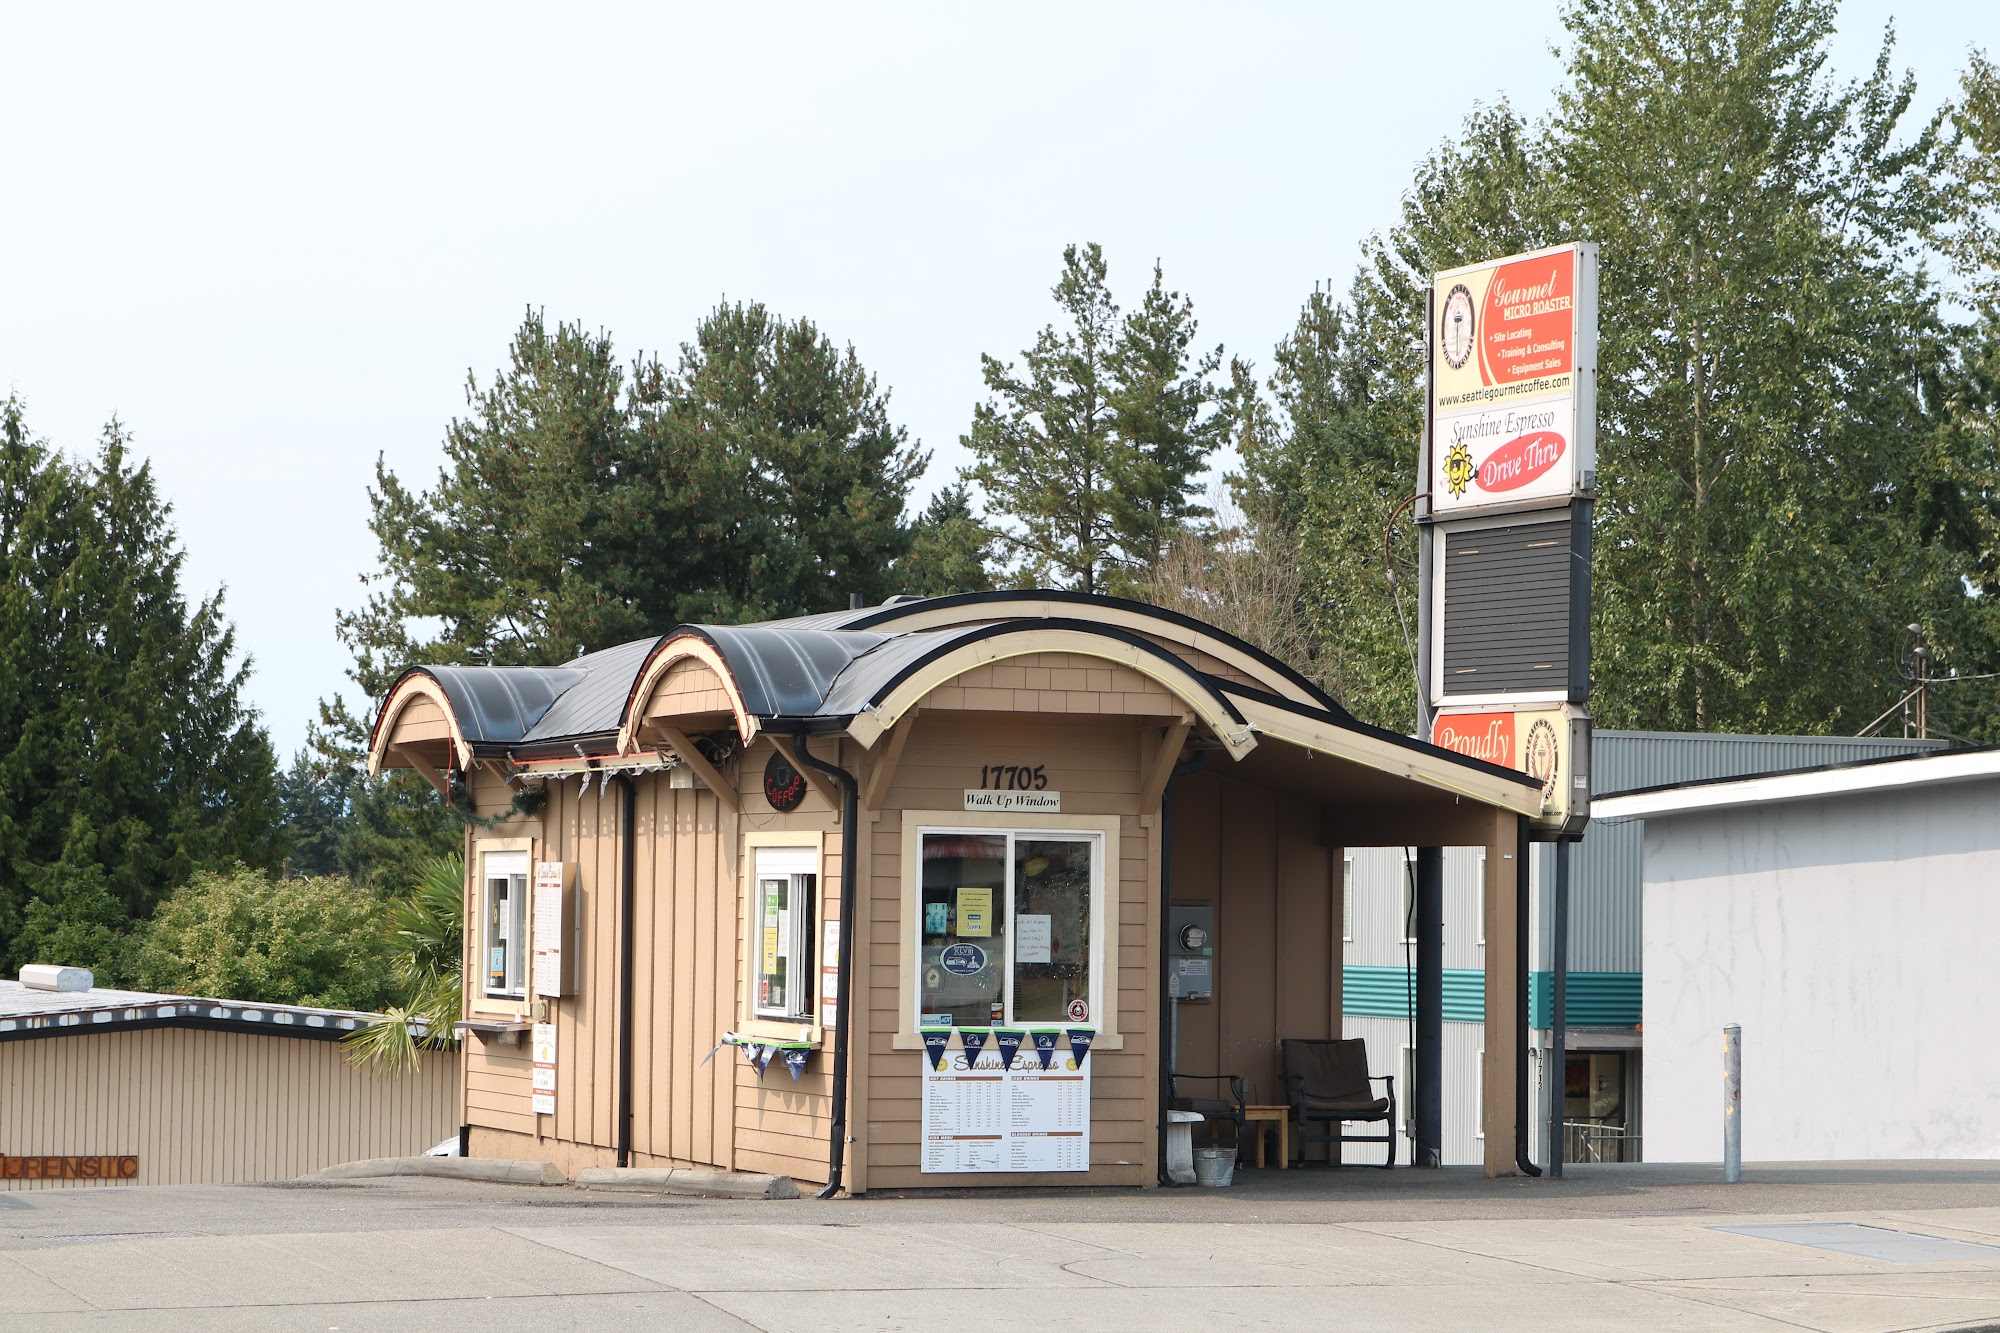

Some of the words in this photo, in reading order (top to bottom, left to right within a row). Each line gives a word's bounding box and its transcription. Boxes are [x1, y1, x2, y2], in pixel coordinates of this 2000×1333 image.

[1493, 269, 1557, 307] Gourmet
[1503, 302, 1531, 319] MICRO
[1533, 296, 1571, 315] ROASTER
[1493, 332, 1505, 343] Site
[1506, 328, 1532, 341] Locating
[1501, 345, 1526, 359] Training
[1527, 344, 1531, 354] &
[1533, 339, 1565, 353] Consulting
[1512, 361, 1544, 375] Equipment
[1545, 358, 1561, 369] Sales
[1439, 376, 1570, 407] www.seattlegourmetcoffee.com
[1451, 413, 1502, 444] Sunshine
[1504, 411, 1555, 439] Espresso
[1483, 454, 1522, 487] Drive
[1524, 437, 1558, 471] Thru
[1439, 720, 1509, 767] Proudly
[980, 765, 1048, 790] 17705
[966, 794, 993, 805] Walk
[997, 795, 1012, 808] Up
[1016, 796, 1059, 807] Window
[954, 1055, 1006, 1071] Snshine
[1009, 1055, 1059, 1073] Espreso
[0, 1157, 137, 1178] ORENSIC
